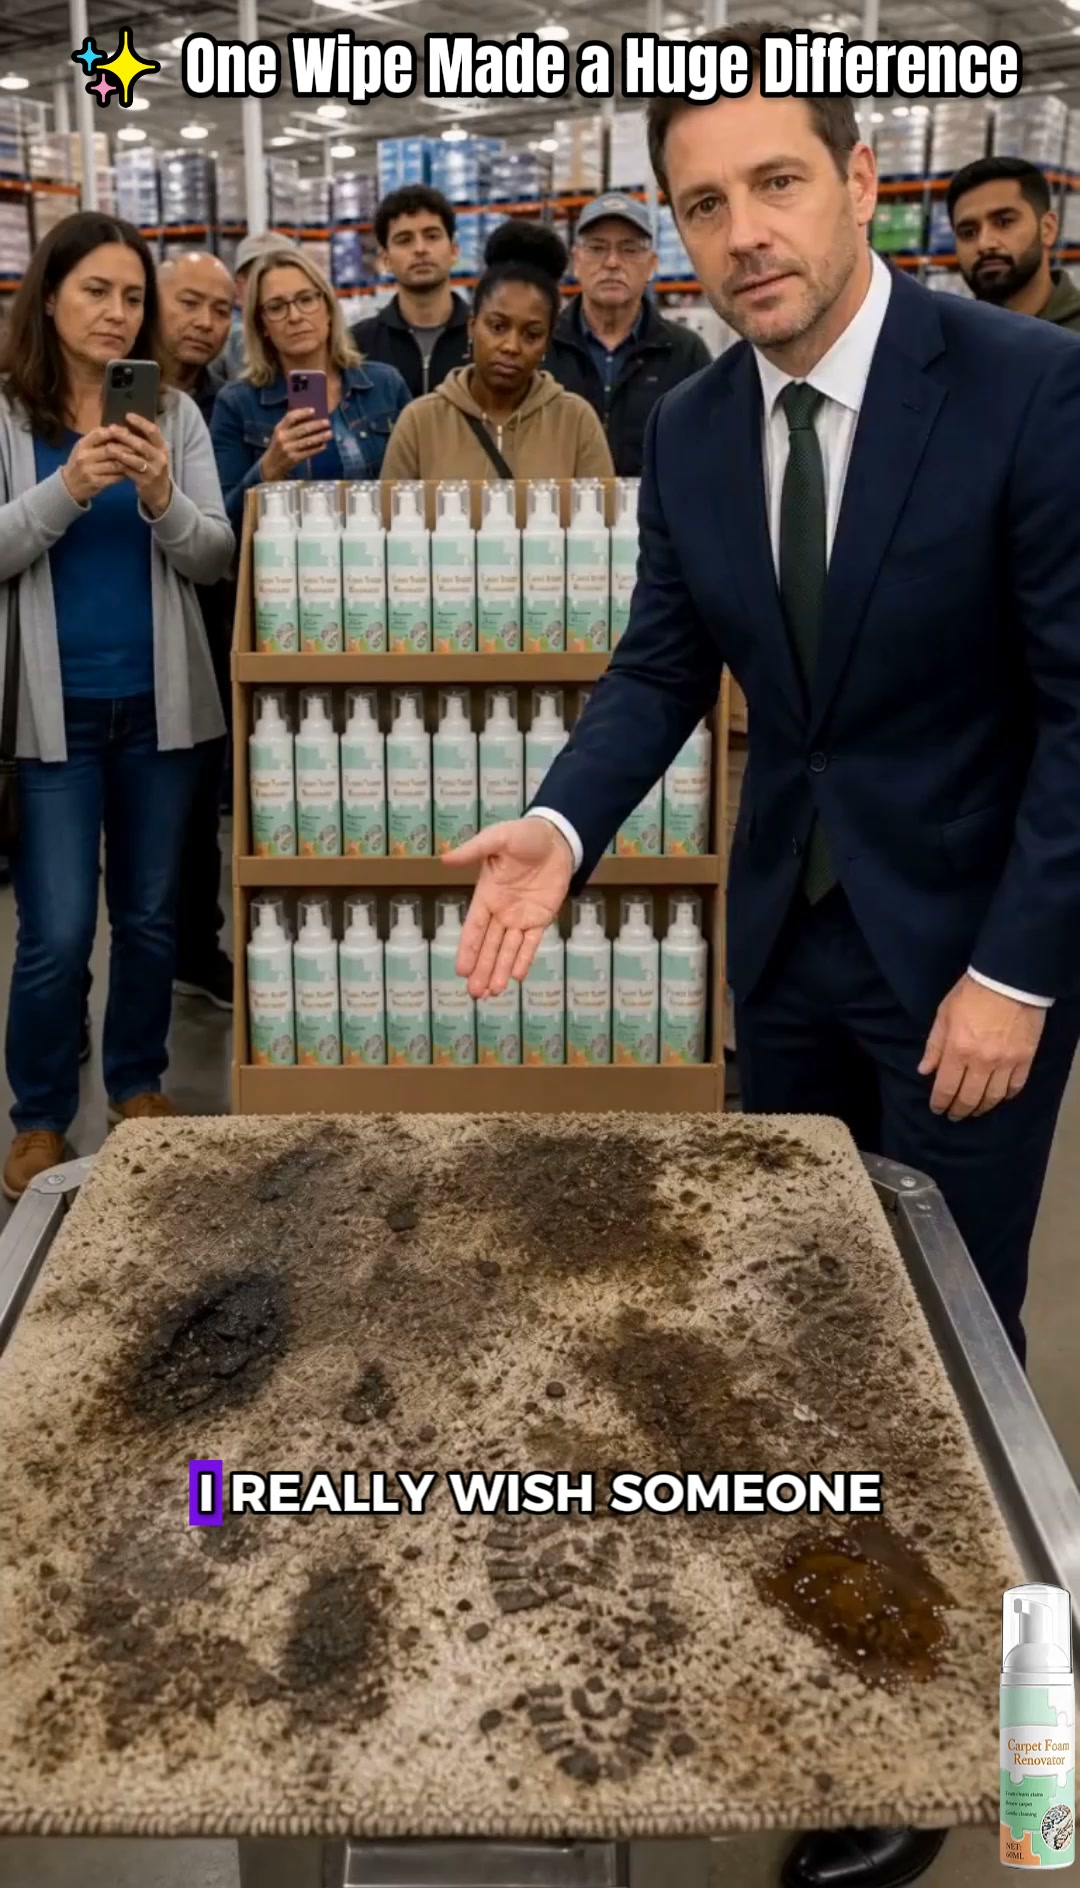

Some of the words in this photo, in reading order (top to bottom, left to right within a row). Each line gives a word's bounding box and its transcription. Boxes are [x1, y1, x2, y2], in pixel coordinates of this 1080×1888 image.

[1007, 1738, 1042, 1754] Carpet
[1045, 1739, 1070, 1751] Foam
[1013, 1752, 1065, 1766] Renovator
[1005, 1842, 1022, 1851] NET:
[1005, 1851, 1025, 1860] 60ML
